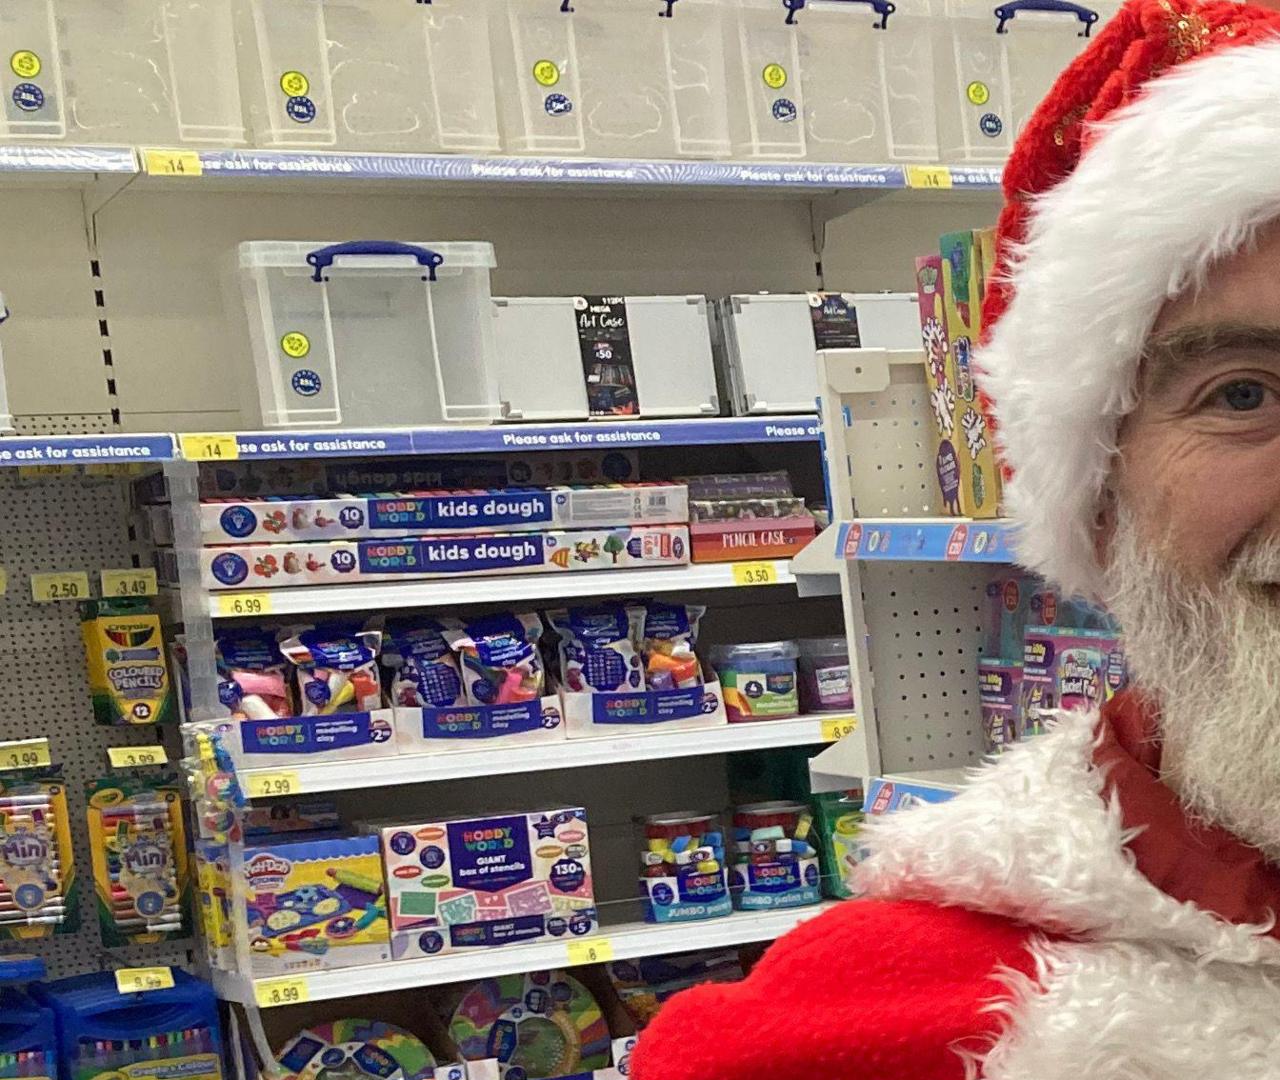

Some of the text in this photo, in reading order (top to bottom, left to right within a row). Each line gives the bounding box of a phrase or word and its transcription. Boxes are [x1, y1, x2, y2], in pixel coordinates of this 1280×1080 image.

[225, 157, 353, 172] ask for assistance
[471, 163, 634, 179] Please ask for assistance
[740, 169, 886, 183] Please ask for assistance
[579, 313, 624, 328] Art Case
[503, 429, 661, 446] Please ask for assistance
[766, 425, 804, 438] Please
[16, 444, 151, 459] ask for assistance
[261, 438, 387, 452] ask for assistance
[375, 501, 424, 514] HOBBY
[437, 498, 545, 520] kids dough
[343, 509, 360, 523] 10
[377, 510, 426, 522] WORLD
[722, 529, 786, 549] PENCIL CASE
[366, 546, 415, 558] HOBBY
[428, 541, 537, 563] kids dough
[335, 554, 353, 567] 10
[367, 555, 417, 567] WORLD
[108, 666, 165, 683] COLOURED
[115, 676, 162, 690] PENCILS
[134, 704, 150, 718] 12
[436, 712, 481, 724] HOBBY
[256, 723, 304, 737] HOBBY
[437, 721, 482, 732] WORLD
[257, 733, 305, 746] WORLD
[461, 827, 513, 842] HOBBY
[1, 838, 49, 861] Mini
[463, 838, 515, 852] WORLD
[124, 843, 167, 870] Mini
[476, 854, 507, 866] GIANT
[459, 862, 525, 877] box of stencils
[668, 904, 704, 918] JUMBO
